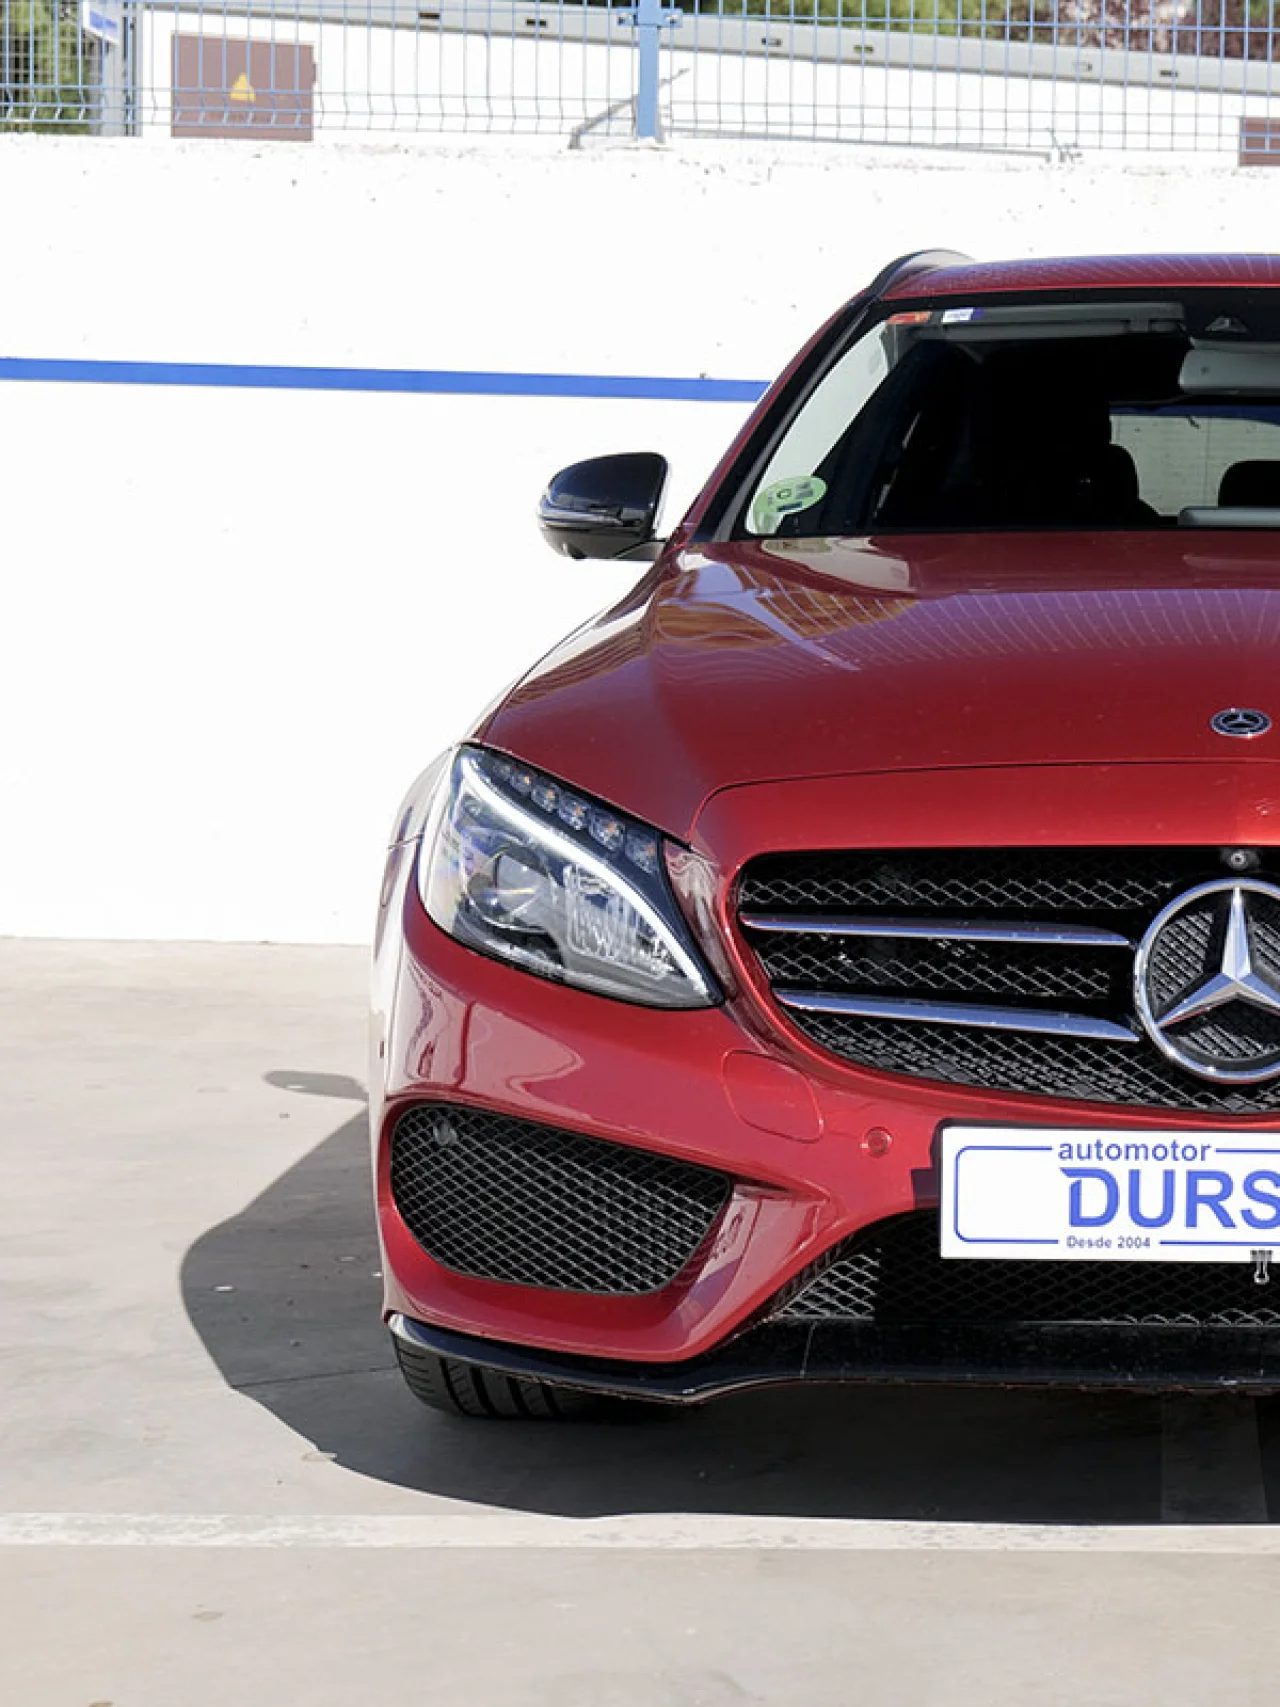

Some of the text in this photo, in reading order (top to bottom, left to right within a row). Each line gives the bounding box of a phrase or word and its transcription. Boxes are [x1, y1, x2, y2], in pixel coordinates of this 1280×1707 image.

[1058, 1140, 1212, 1161] automotor
[1066, 1235, 1151, 1249] Desde 2004
